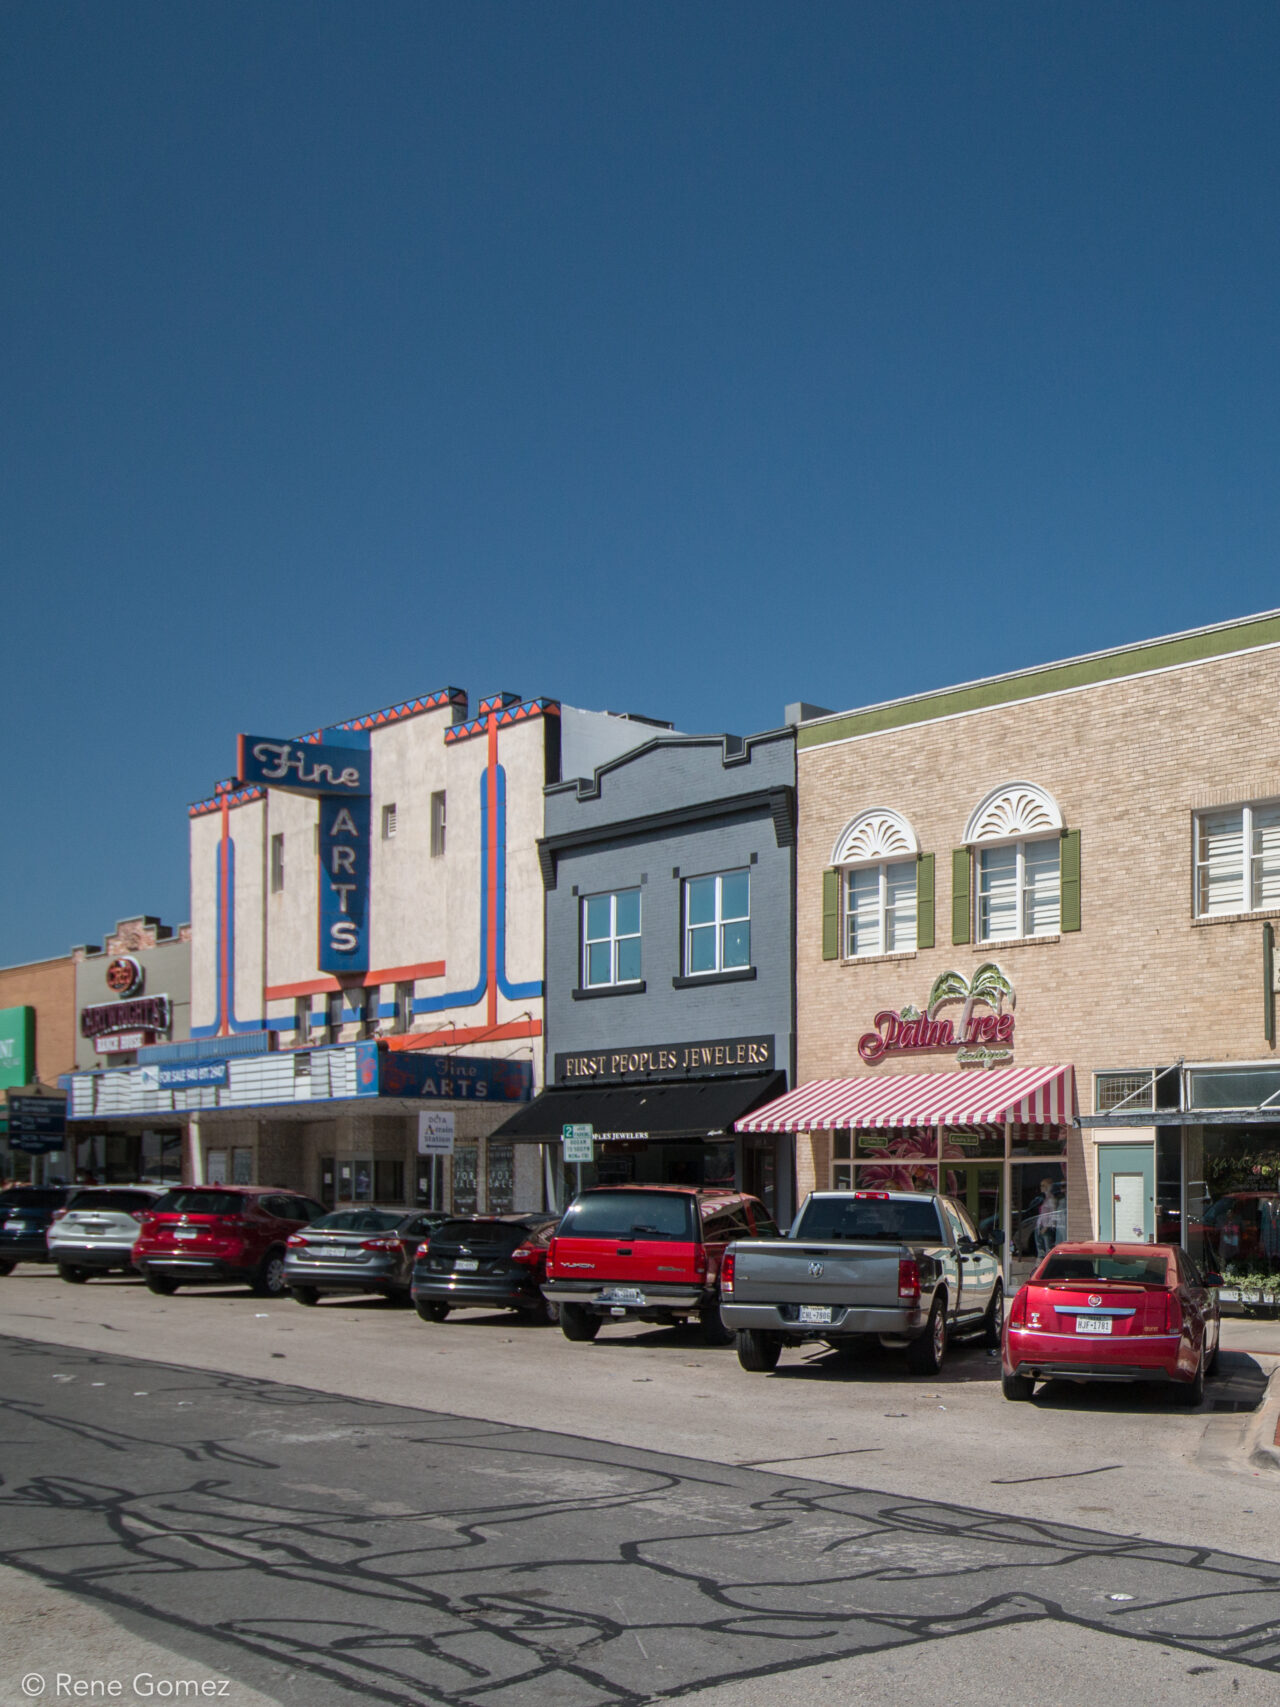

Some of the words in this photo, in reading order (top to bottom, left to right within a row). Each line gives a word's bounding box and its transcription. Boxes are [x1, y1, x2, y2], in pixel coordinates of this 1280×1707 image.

[253, 743, 361, 788] Fine
[329, 807, 359, 951] ARTS
[858, 1009, 953, 1060] Palm
[435, 1058, 477, 1077] Fine
[566, 1056, 607, 1077] FIRST
[611, 1050, 677, 1074] PEOPLES
[682, 1043, 769, 1068] JEWELERS
[421, 1079, 488, 1097] ARTS
[566, 1126, 573, 1138] 2
[613, 1132, 649, 1140] JEWELERS
